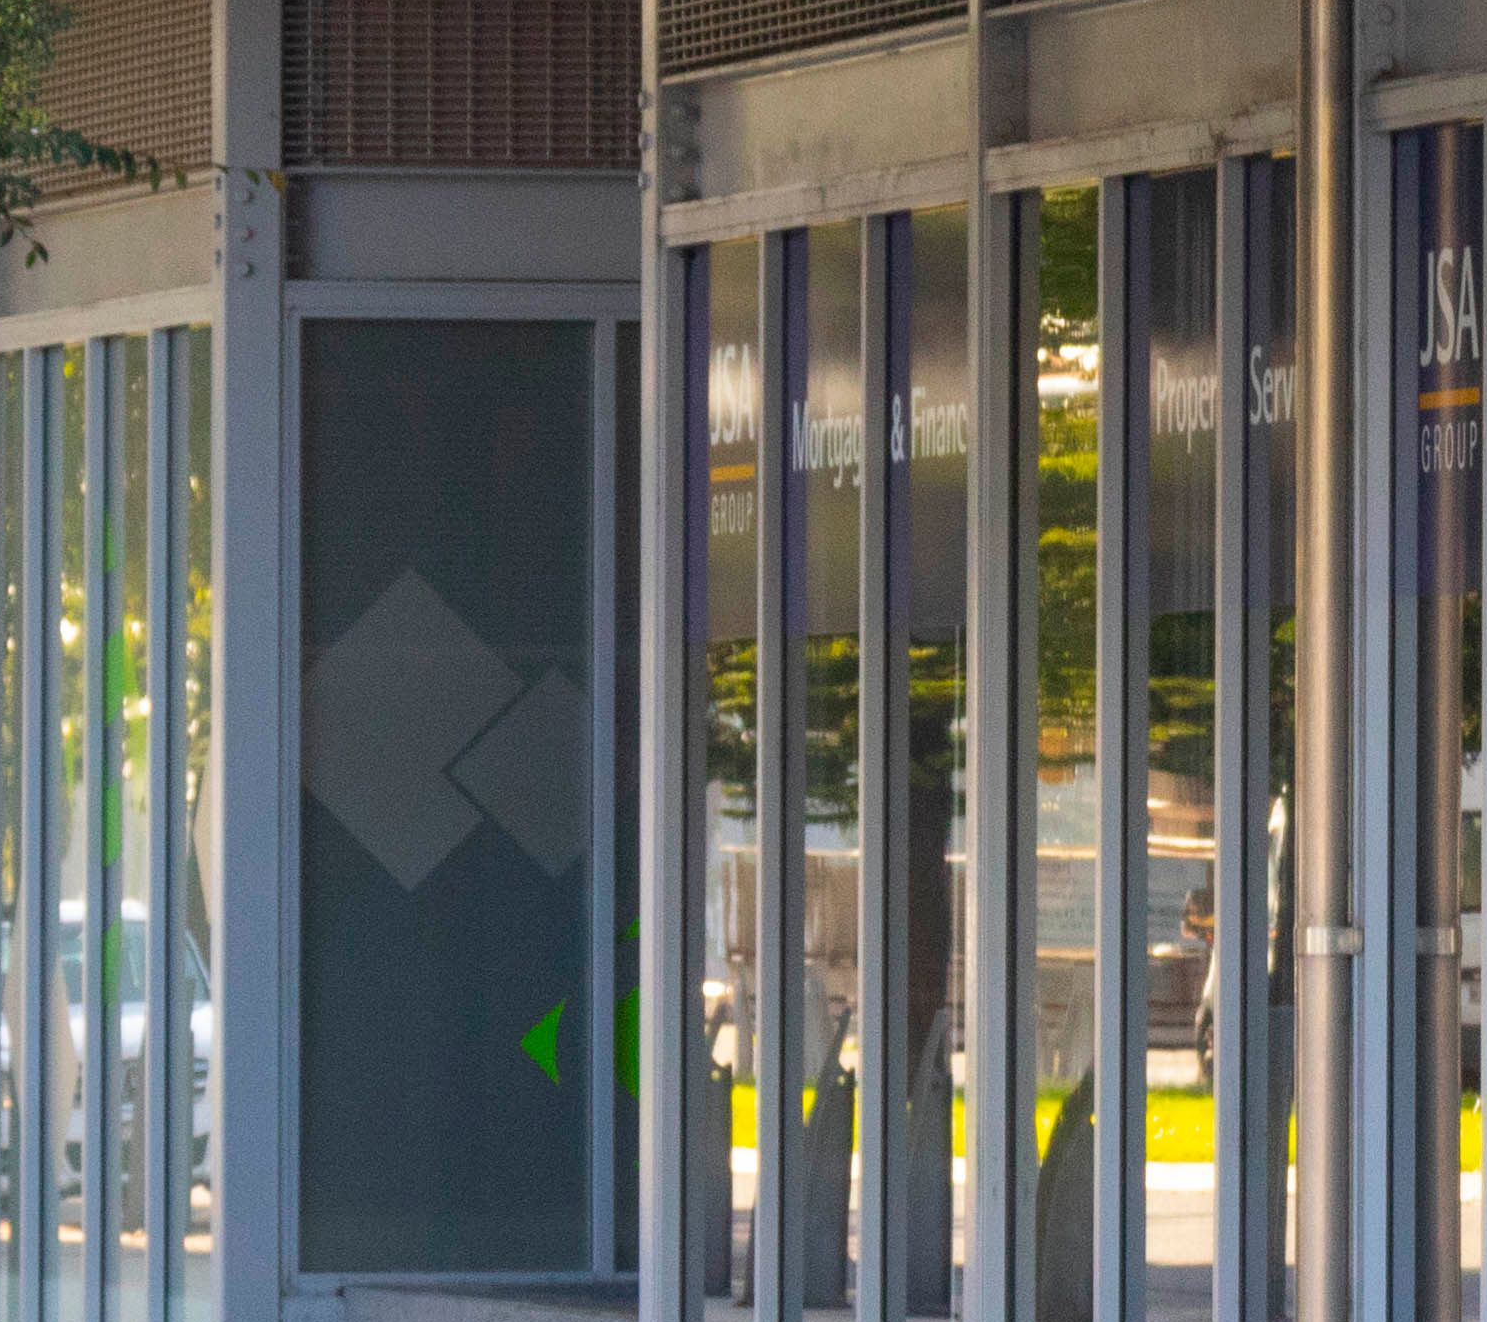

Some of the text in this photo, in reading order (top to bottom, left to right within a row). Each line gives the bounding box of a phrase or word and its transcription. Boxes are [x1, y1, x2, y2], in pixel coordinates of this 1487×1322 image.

[1420, 246, 1479, 367] JSA
[793, 387, 967, 489] Mortgag & Financ
[1156, 344, 1296, 454] Proper Serv
[1420, 422, 1479, 472] GROUP
[711, 492, 754, 536] GROUP
